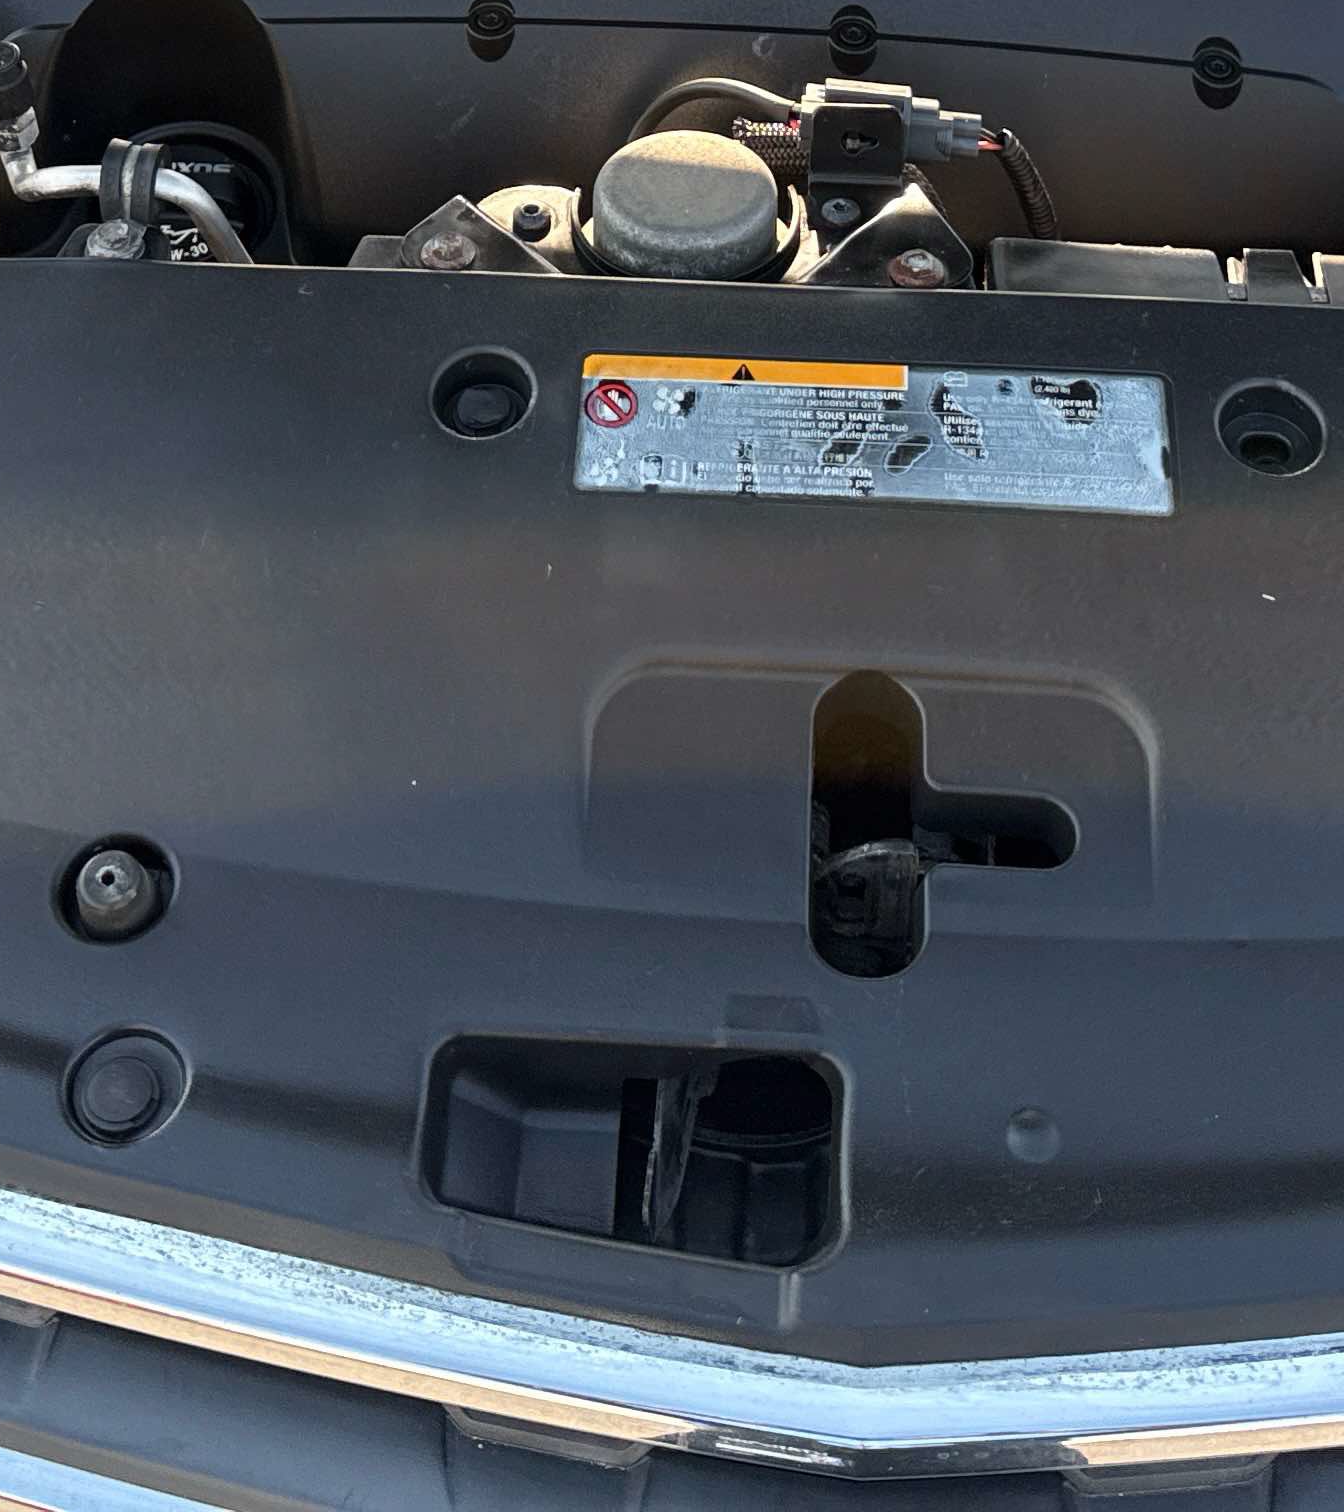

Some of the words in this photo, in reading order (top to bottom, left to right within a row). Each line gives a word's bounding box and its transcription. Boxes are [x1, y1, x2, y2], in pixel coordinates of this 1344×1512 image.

[170, 242, 208, 261] W-30
[818, 389, 845, 398] HIGH
[848, 390, 905, 401] PRESSURE
[806, 398, 858, 408] personnel
[816, 410, 846, 420] SOUS
[849, 412, 885, 422] HAUTE
[782, 465, 791, 474] A
[793, 464, 821, 475] ALTA
